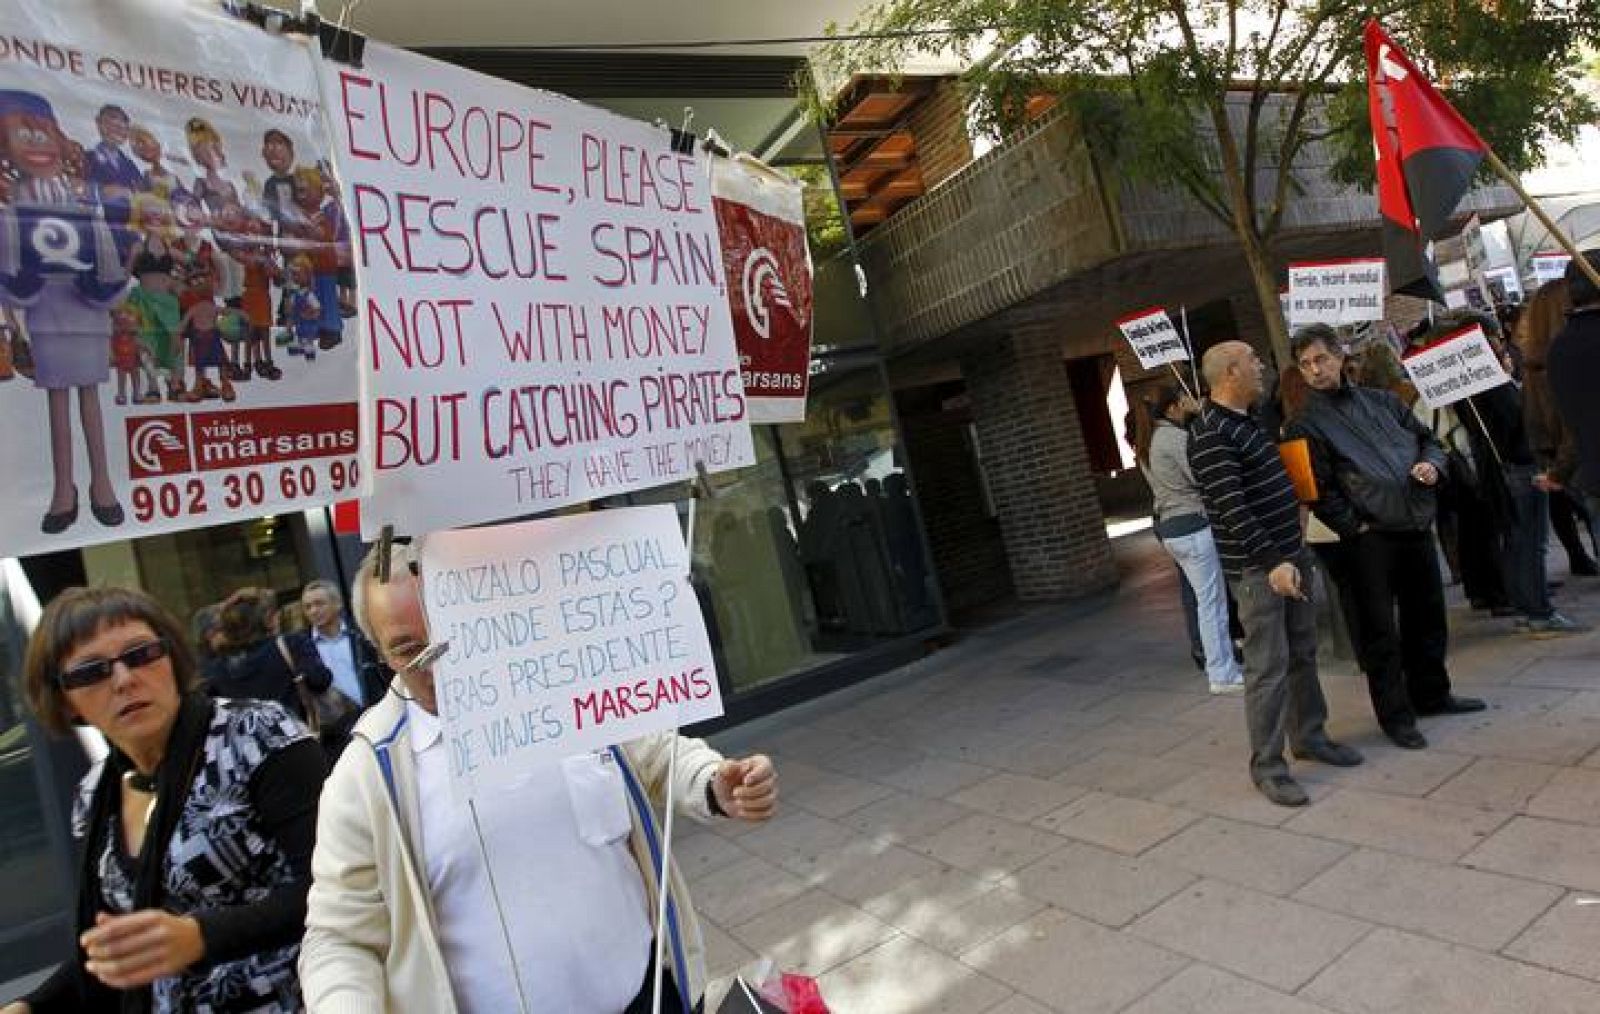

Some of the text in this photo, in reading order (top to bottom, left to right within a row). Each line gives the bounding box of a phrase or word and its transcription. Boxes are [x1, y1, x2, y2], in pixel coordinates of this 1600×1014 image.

[97, 57, 223, 103] QUIERES
[339, 71, 702, 213] EUROPE, PLEASE
[353, 184, 568, 280] RESCUE
[367, 297, 710, 371] NOT WITH MONEY
[201, 417, 254, 441] viajes
[202, 429, 355, 461] marsans
[375, 366, 745, 471] BUT CATCHING PIRATES
[132, 458, 359, 522] 902 30 60 90
[509, 460, 572, 504] THEY
[586, 449, 641, 488] HAVE
[644, 442, 678, 476] THE
[559, 536, 679, 587] PASCUAL
[507, 625, 689, 697] PRESIDENTE
[451, 668, 712, 777] DE VIAJES MARSANS
